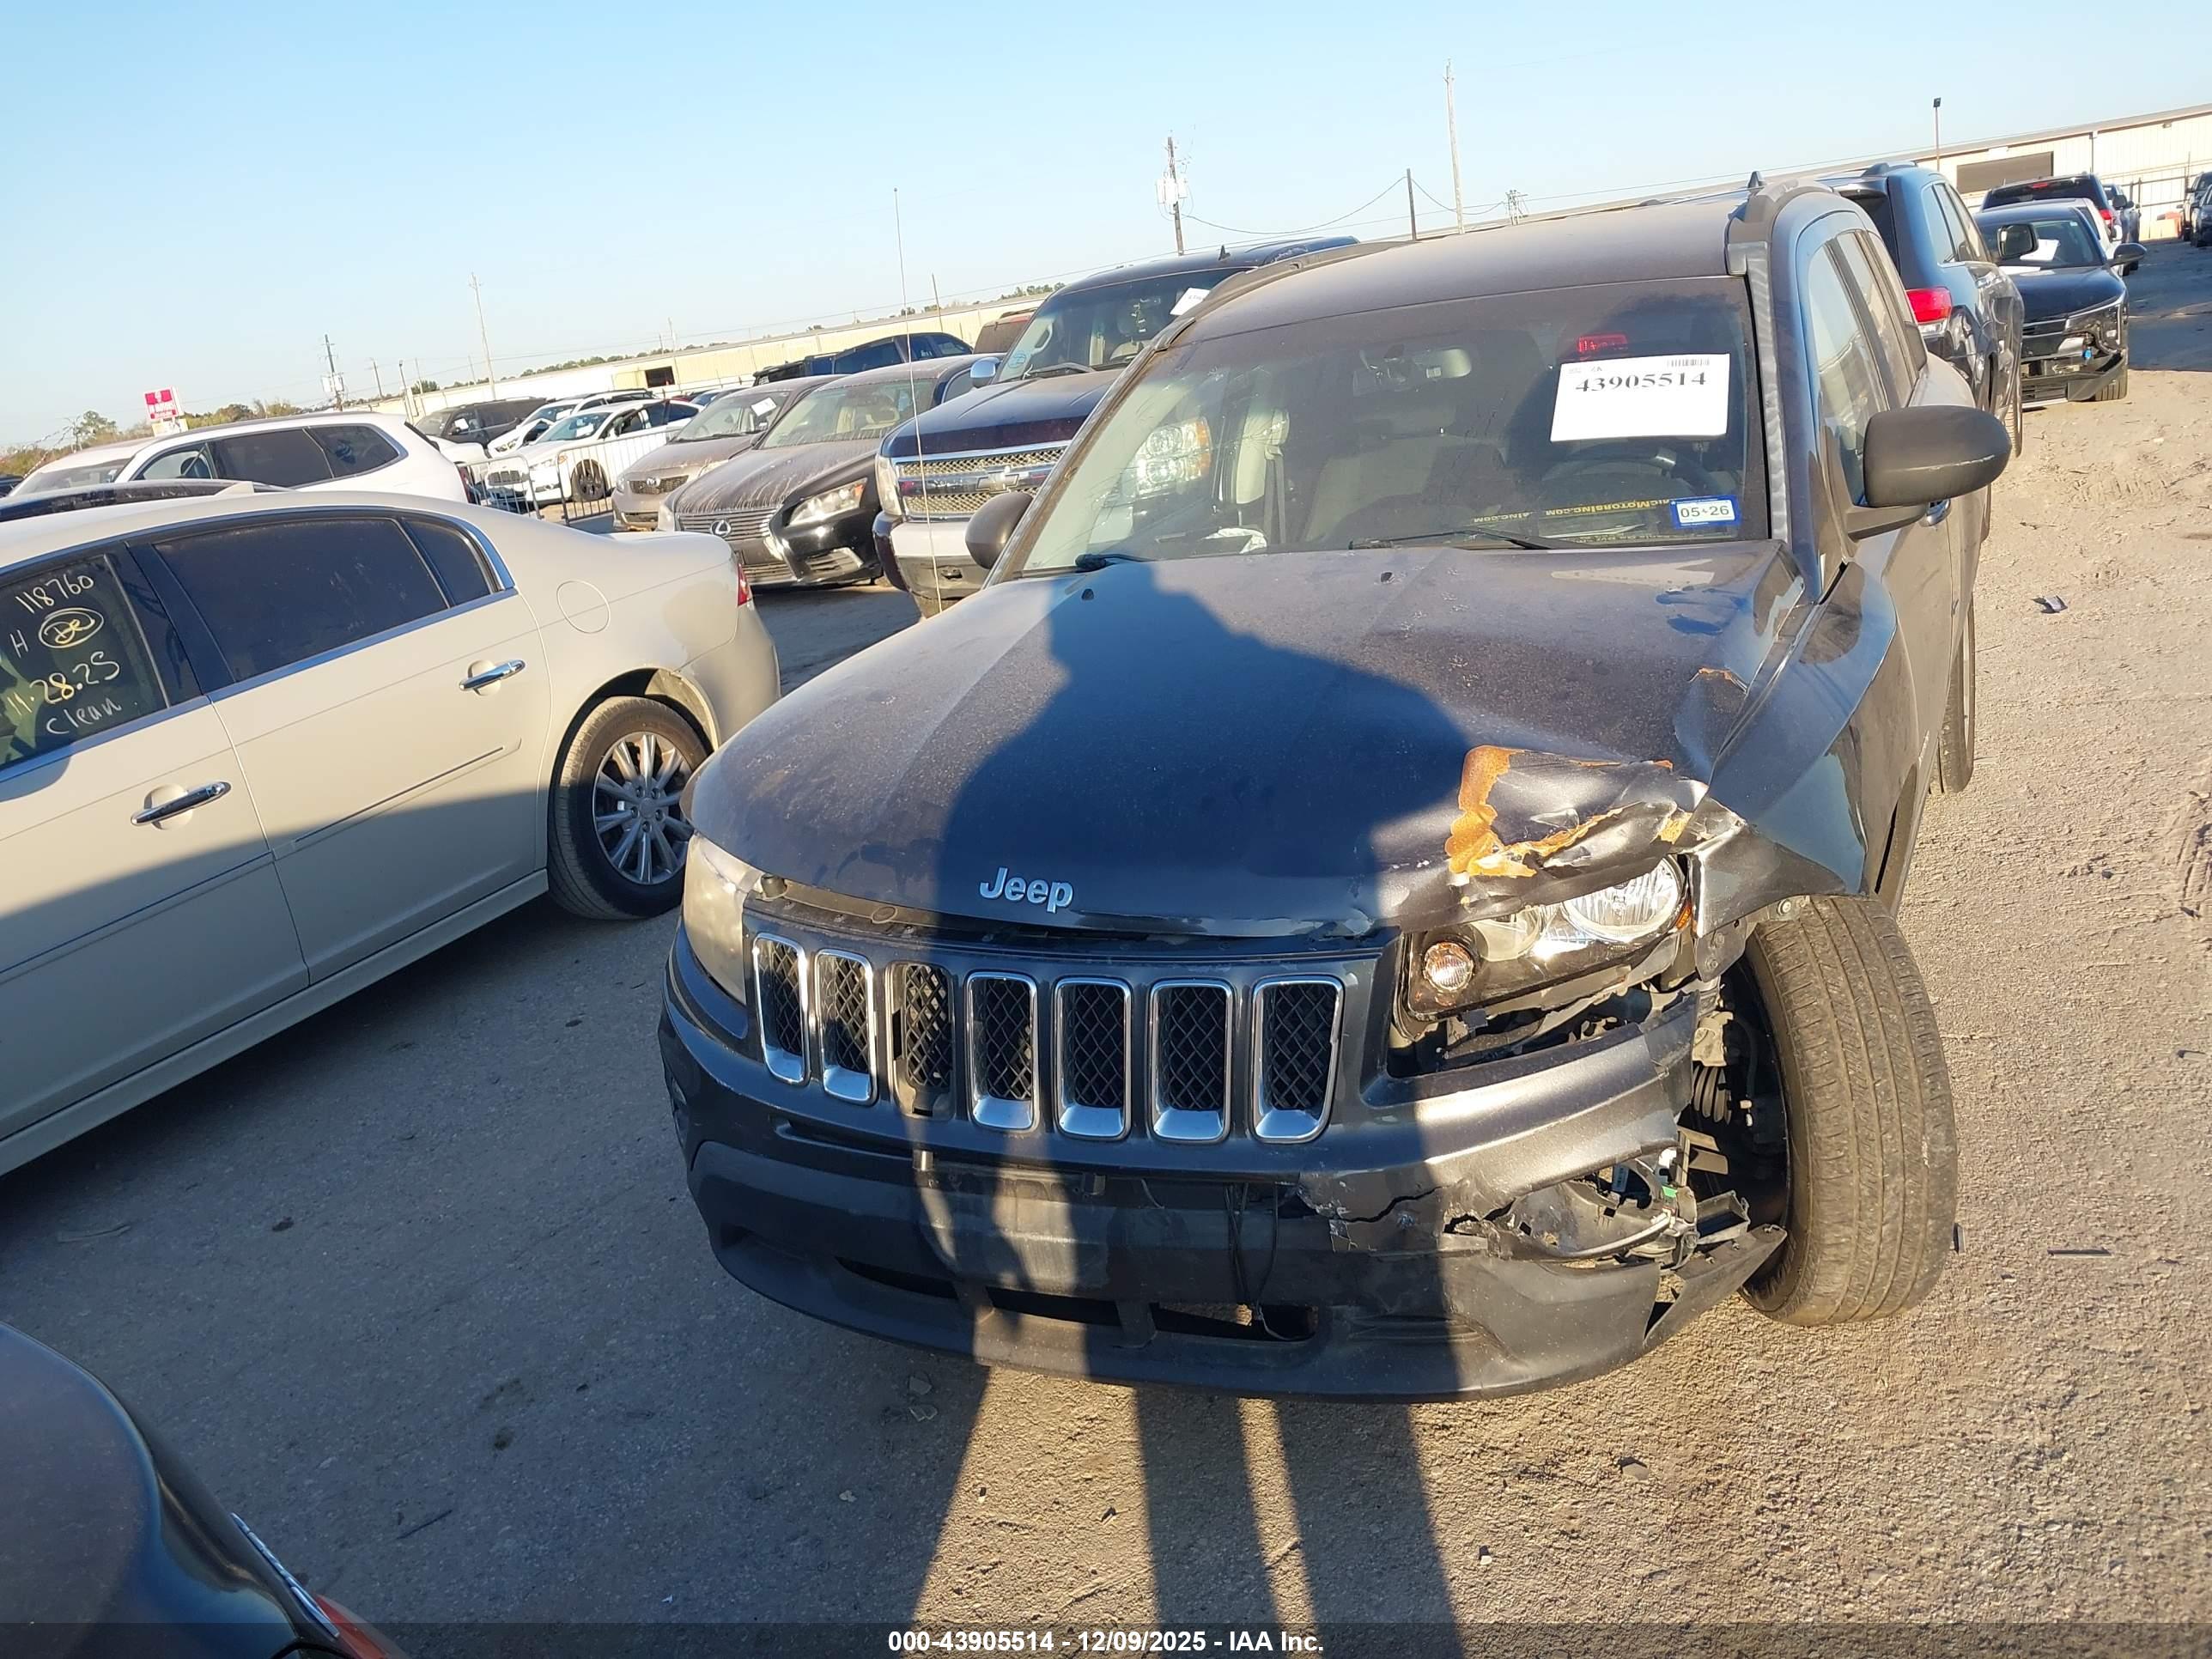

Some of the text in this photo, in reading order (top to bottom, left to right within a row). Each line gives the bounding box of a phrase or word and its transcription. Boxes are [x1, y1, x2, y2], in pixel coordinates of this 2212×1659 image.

[1575, 371, 1707, 392] 43905514
[1680, 505, 1729, 518] 05 26
[15, 574, 94, 615] 118760
[980, 866, 1073, 915] Jeep
